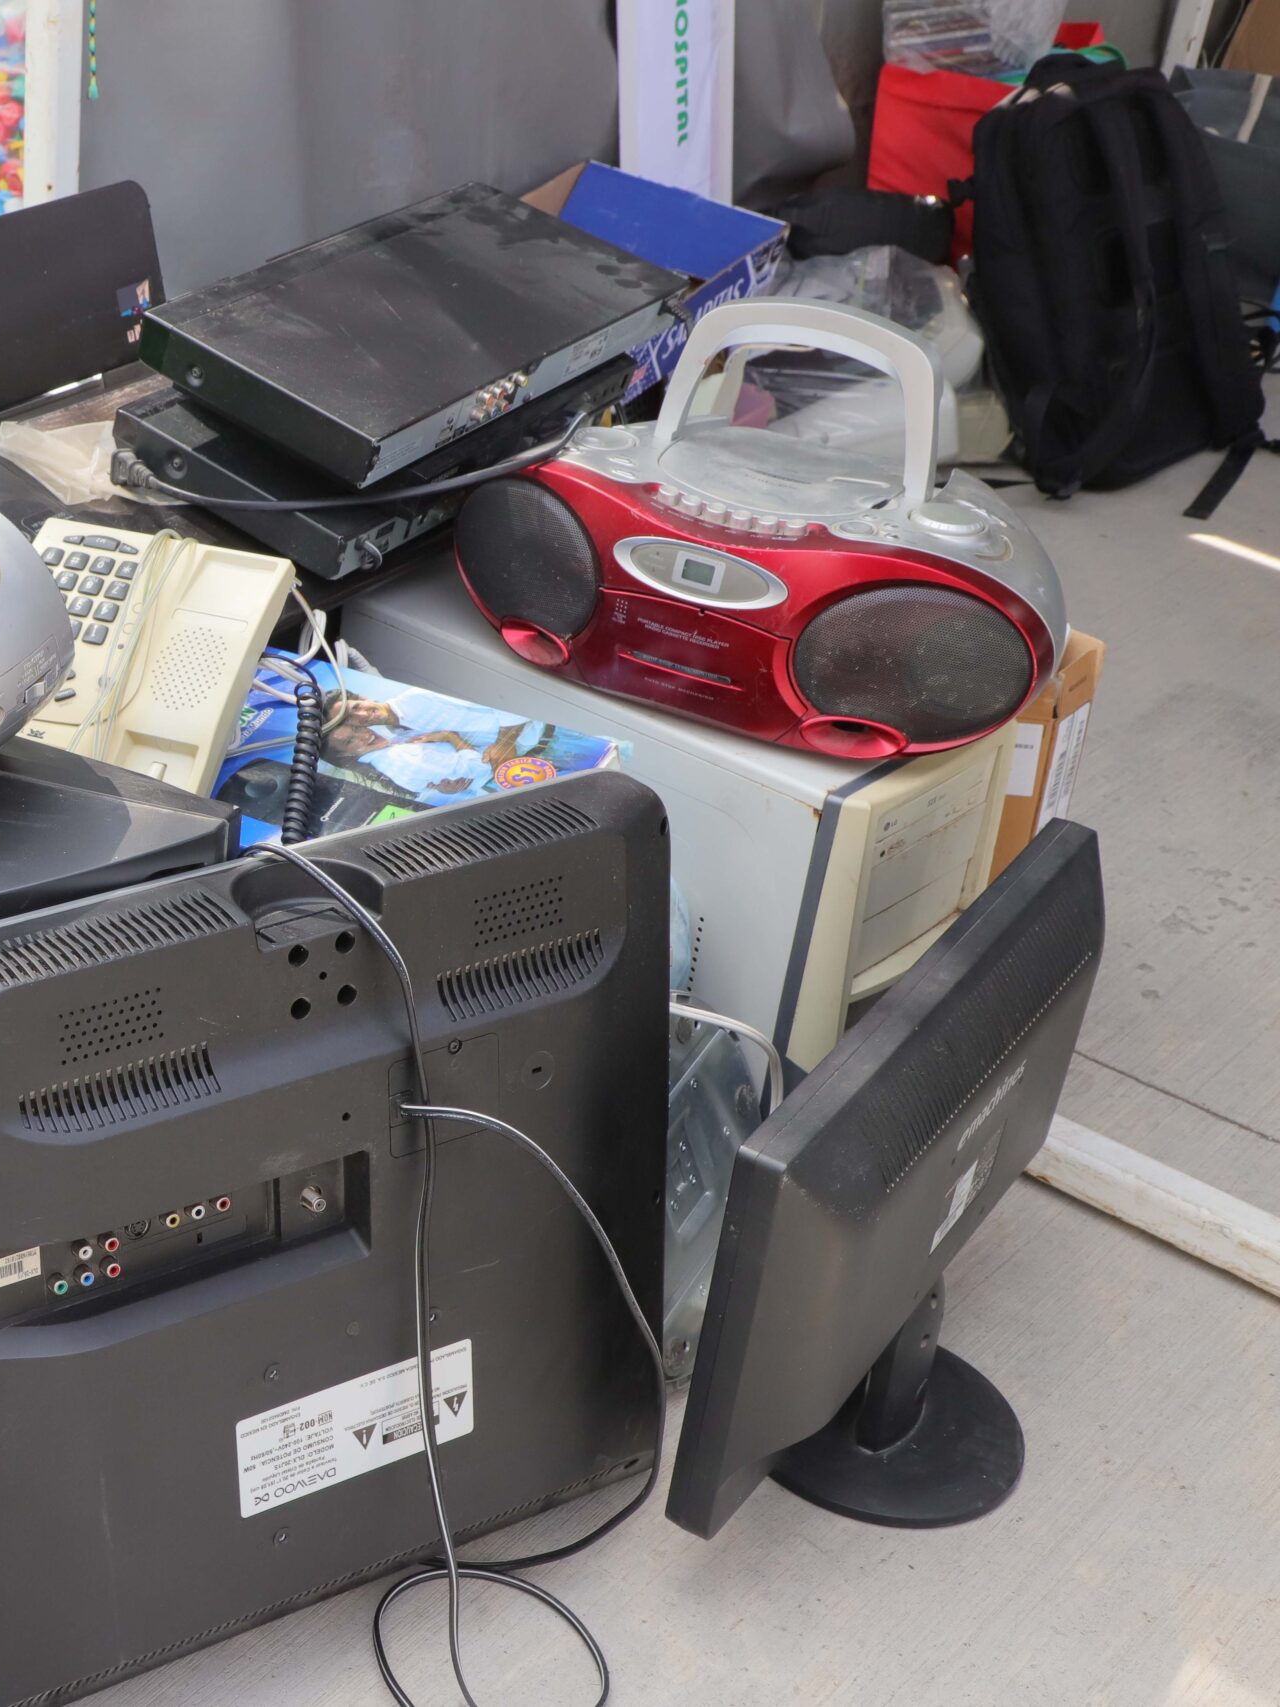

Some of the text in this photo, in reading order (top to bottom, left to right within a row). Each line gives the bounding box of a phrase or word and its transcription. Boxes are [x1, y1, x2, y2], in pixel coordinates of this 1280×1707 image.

[956, 1059, 1027, 1151] emachines
[302, 1435, 334, 1451] CONSUMO
[274, 1467, 337, 1498] DAEWOO
